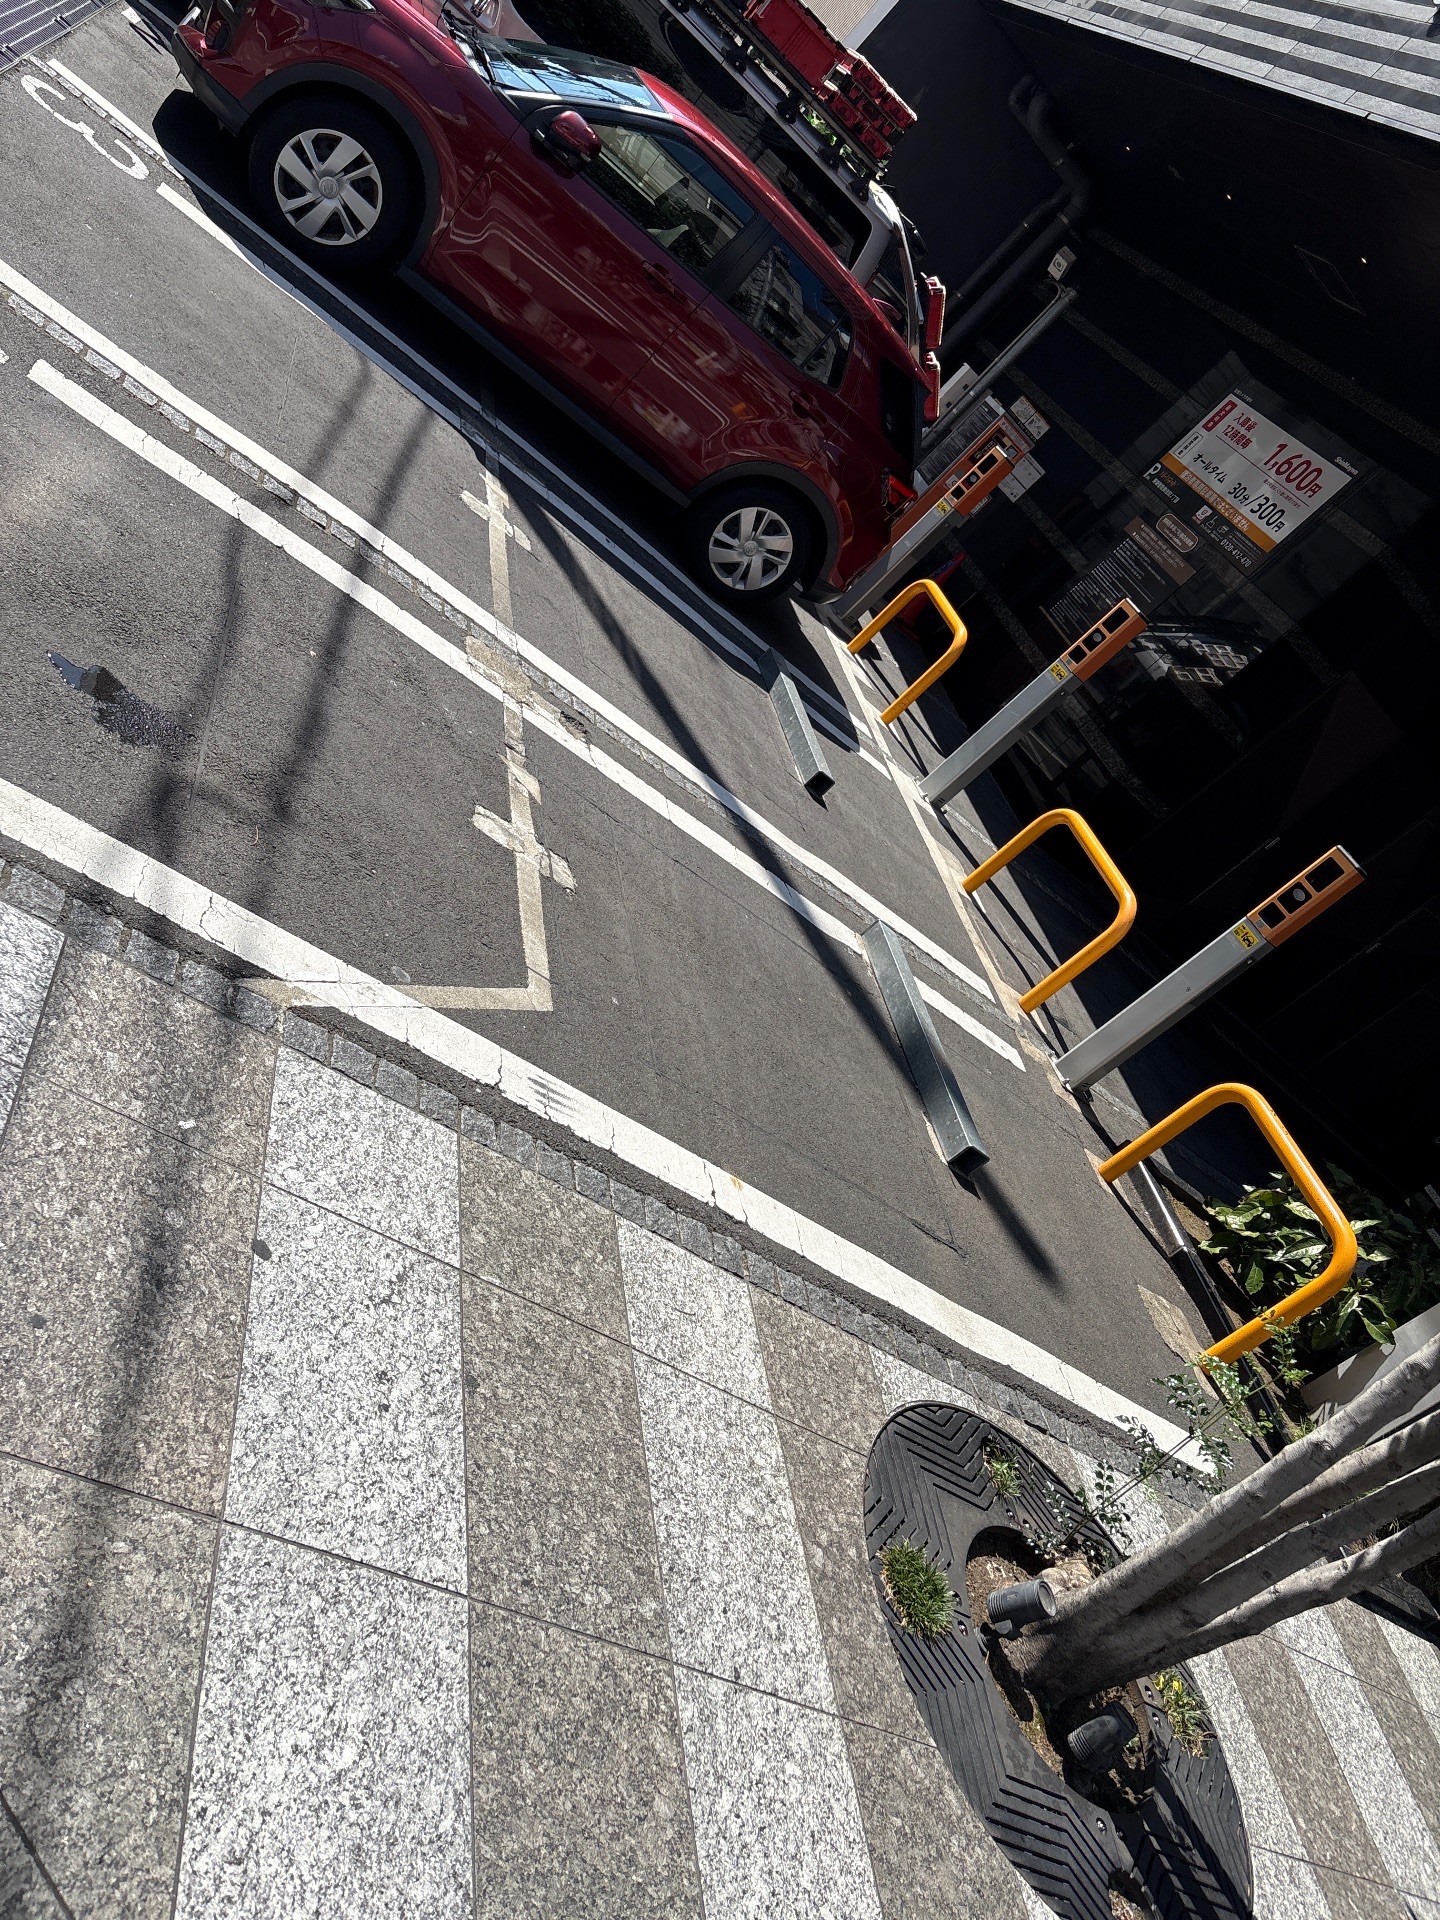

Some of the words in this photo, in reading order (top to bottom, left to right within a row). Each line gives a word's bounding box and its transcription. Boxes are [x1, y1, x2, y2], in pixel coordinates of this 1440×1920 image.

[1233, 412, 1258, 433] 入庫後
[1222, 424, 1253, 450] 12時間毎
[1193, 453, 1228, 484] オールタイム
[1263, 443, 1323, 499] 1,600円
